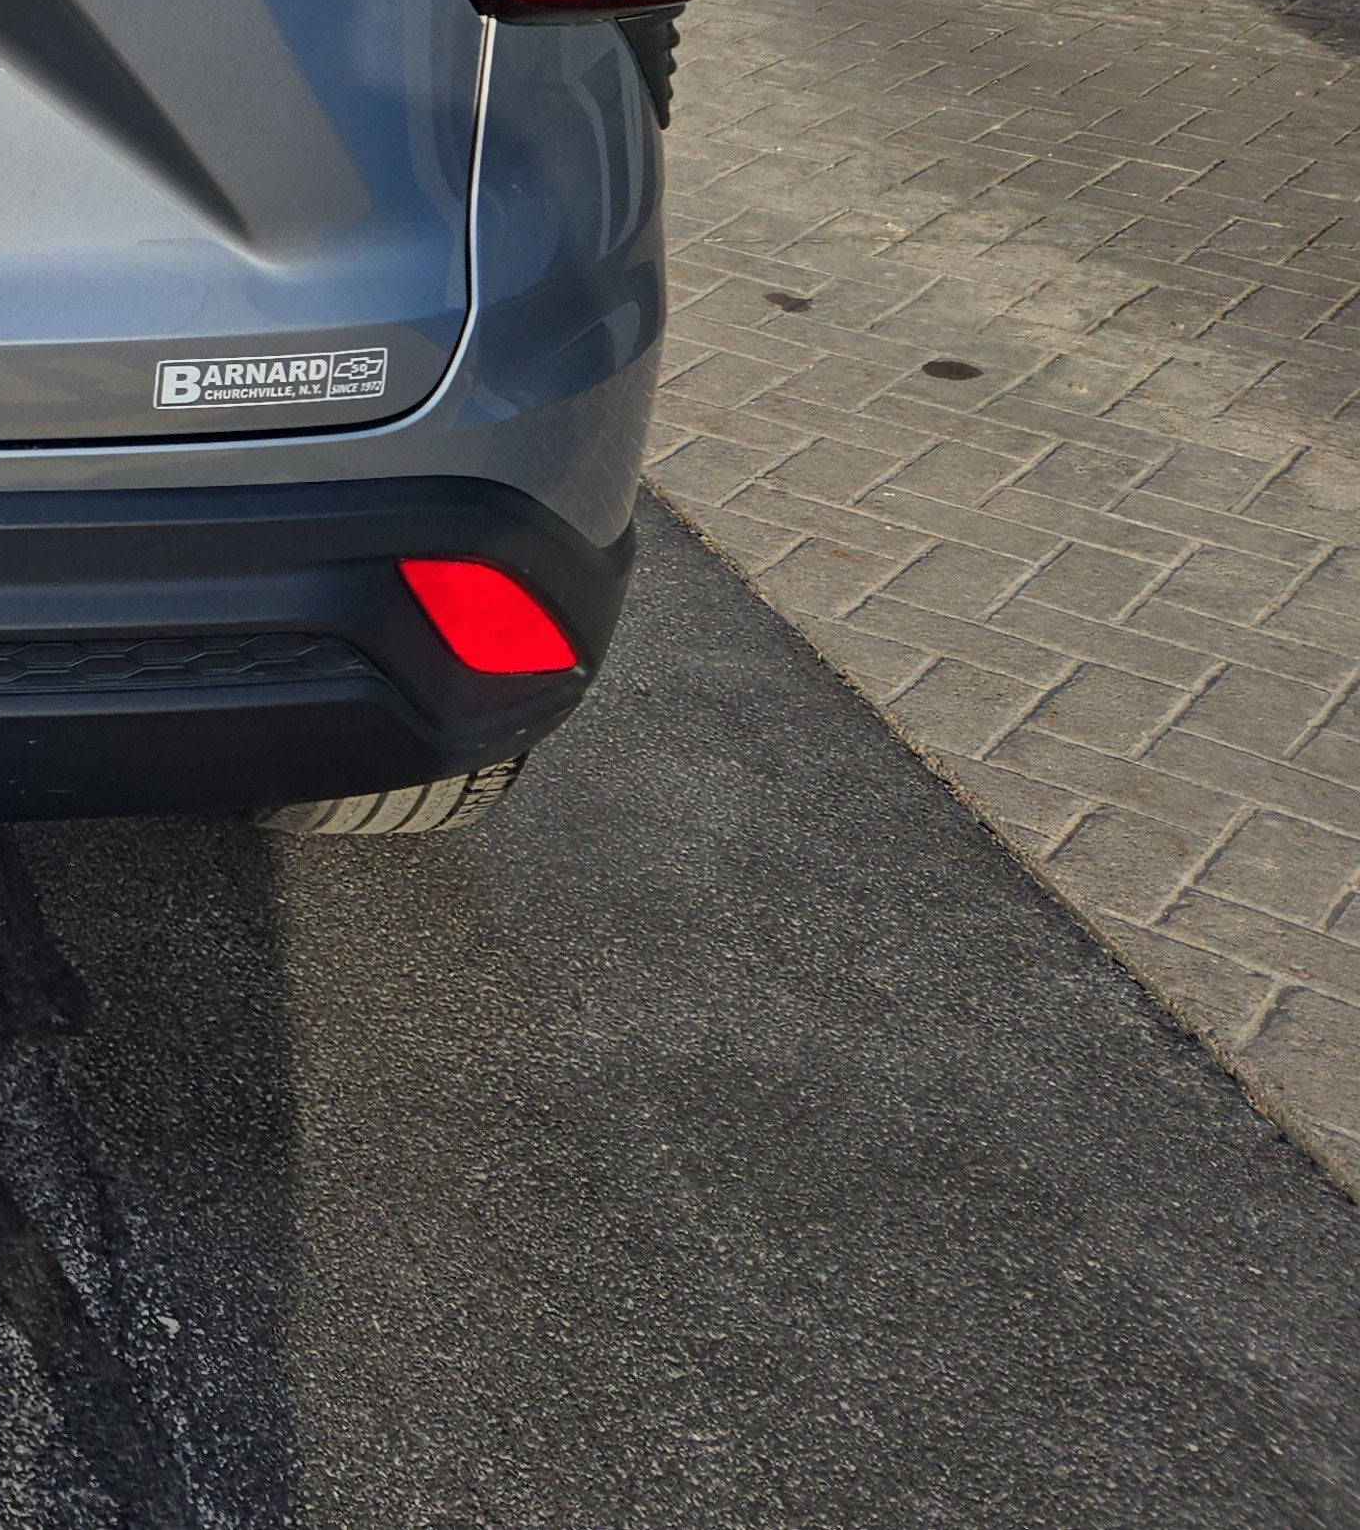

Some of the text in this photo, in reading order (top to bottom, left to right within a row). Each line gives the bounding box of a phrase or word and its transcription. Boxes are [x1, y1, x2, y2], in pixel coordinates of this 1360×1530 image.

[160, 358, 328, 405] BARNARD
[330, 381, 383, 394] SINCE 1972
[204, 384, 322, 401] CHURCHVILLE, N.Y.
